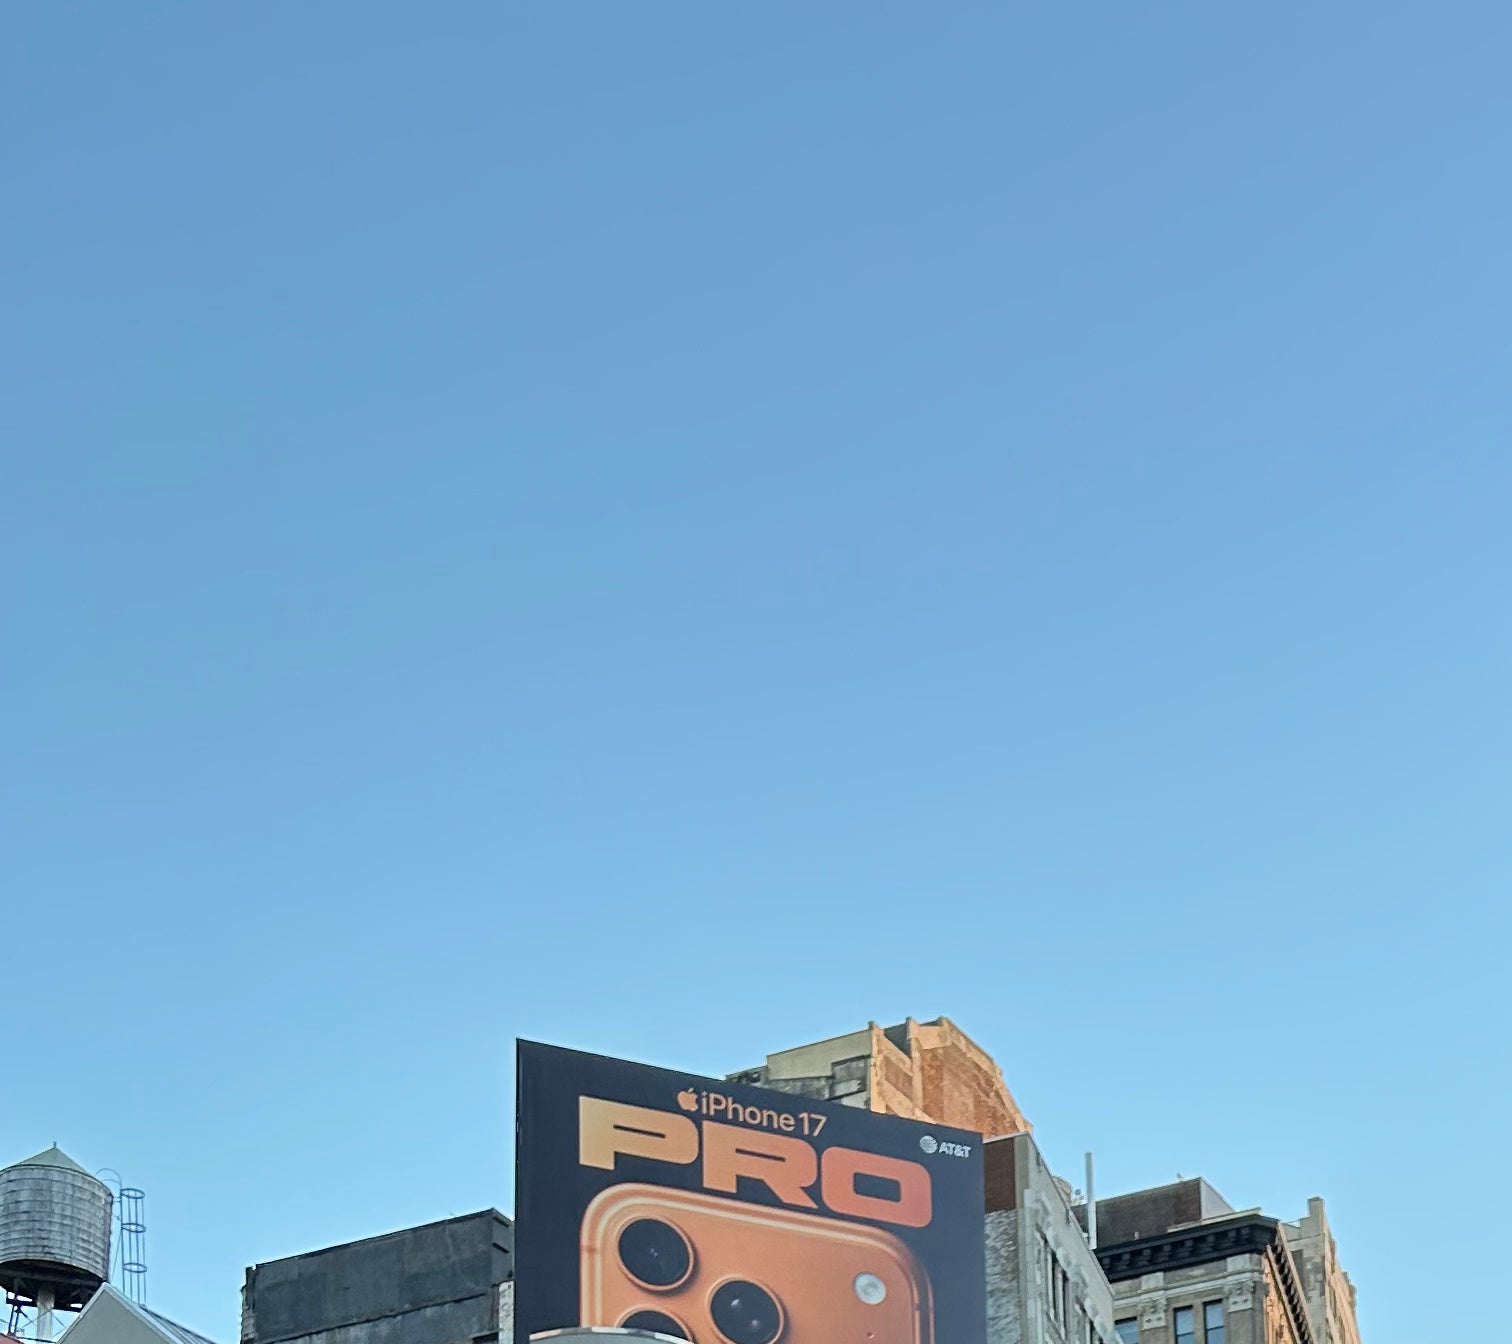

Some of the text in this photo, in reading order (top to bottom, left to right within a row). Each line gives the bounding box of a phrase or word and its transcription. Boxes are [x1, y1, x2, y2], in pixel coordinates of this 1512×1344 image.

[701, 1090, 828, 1138] iPhone 17
[578, 1094, 934, 1229] PRO
[937, 1141, 973, 1159] AT&T
